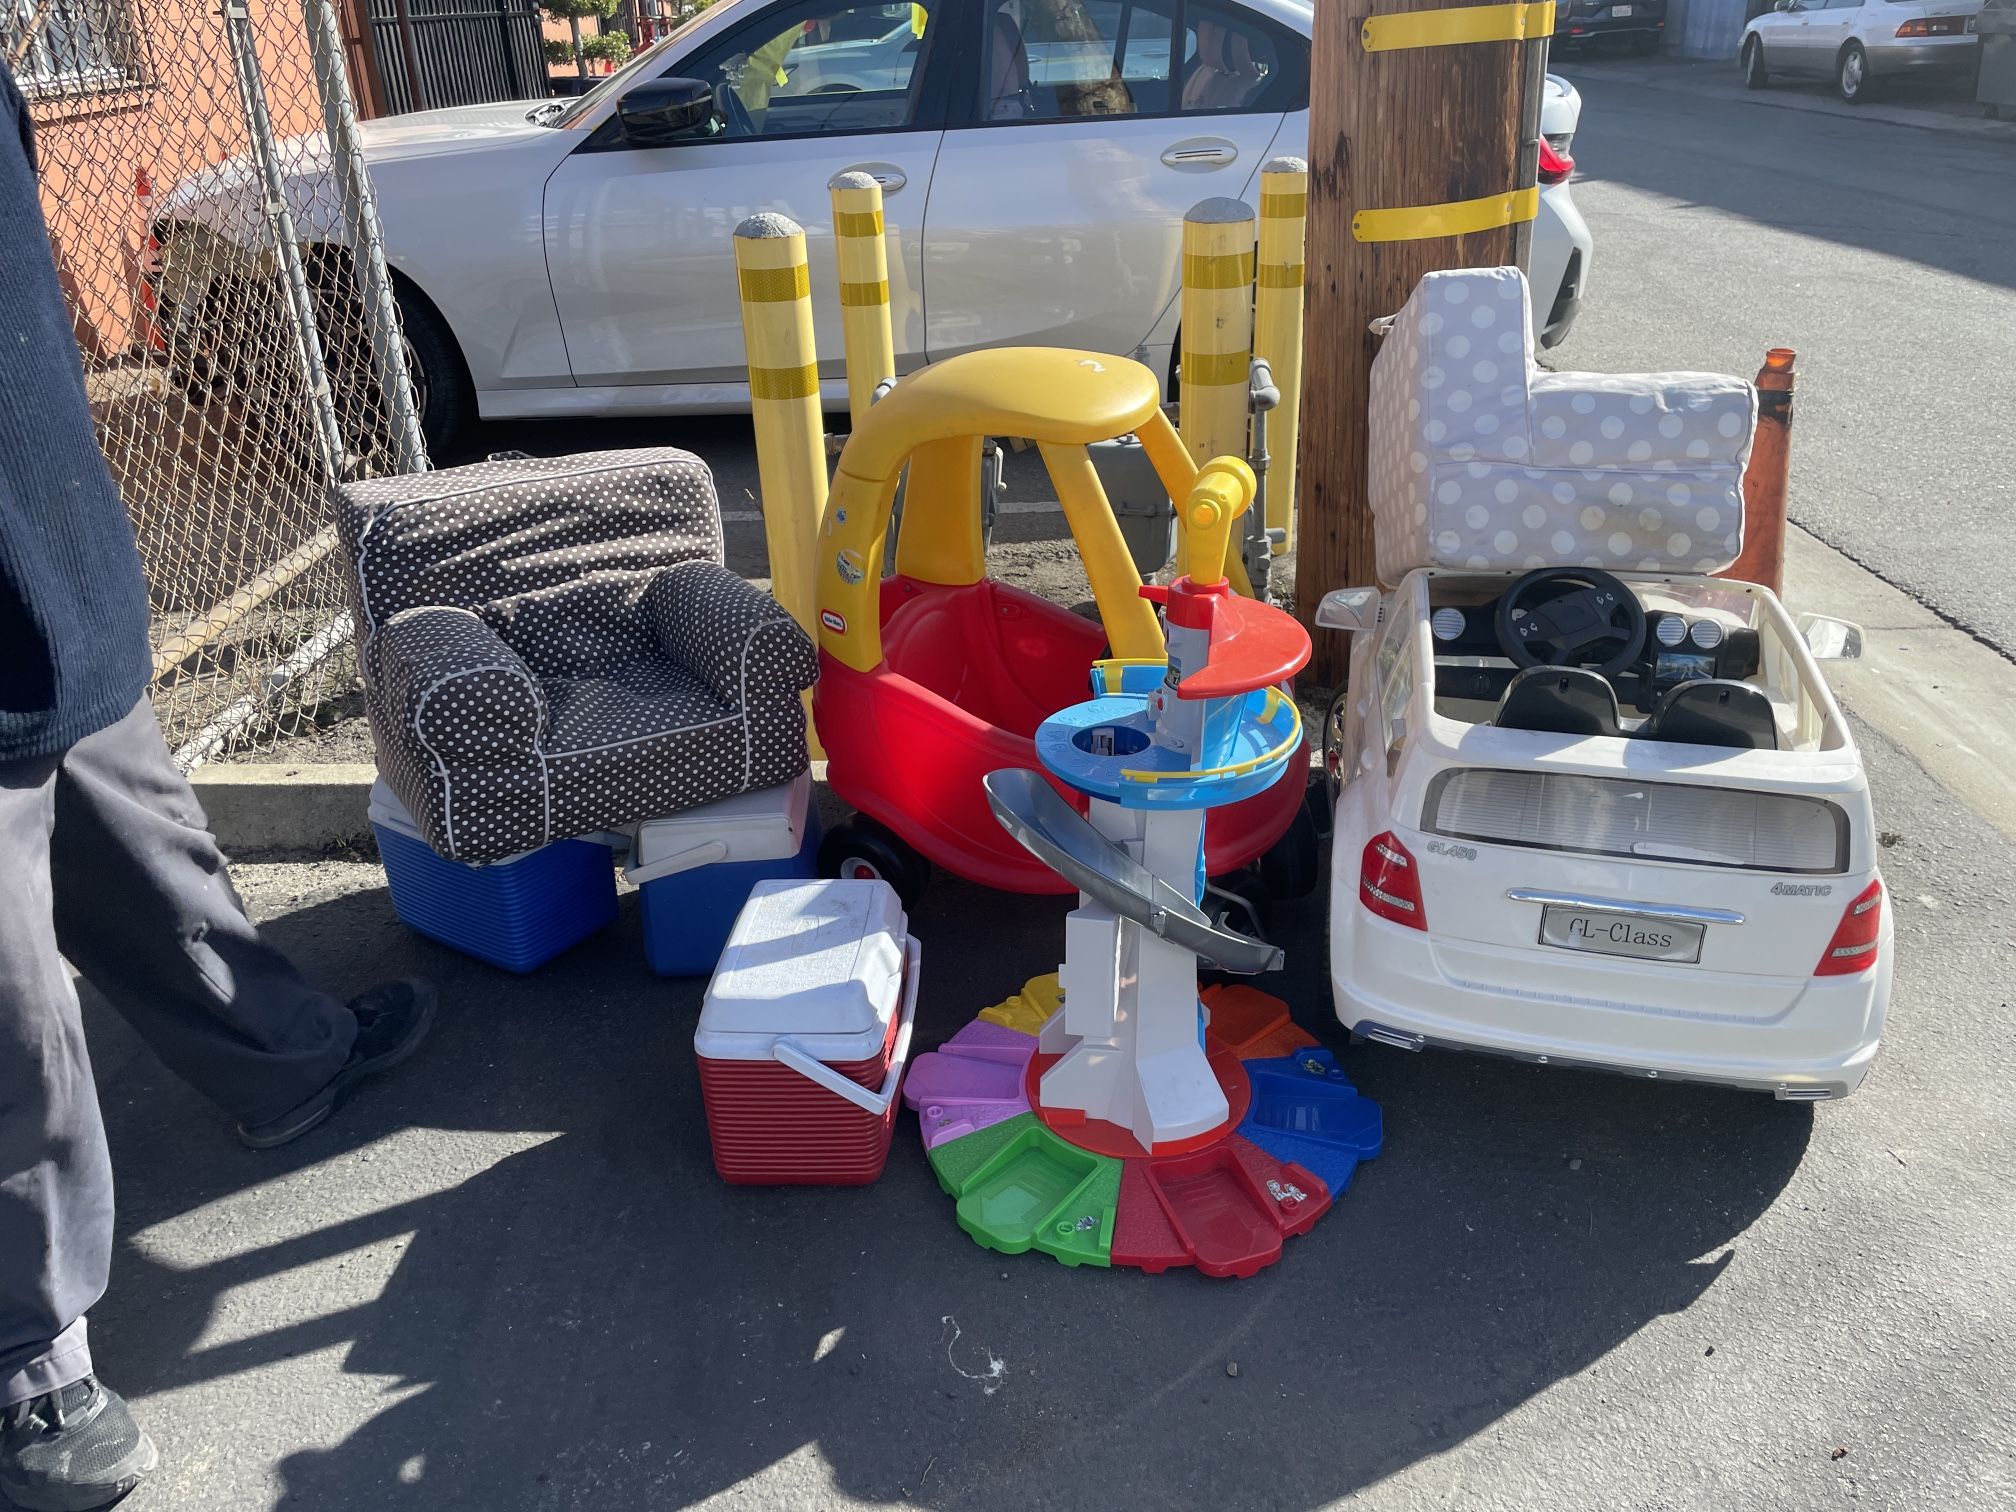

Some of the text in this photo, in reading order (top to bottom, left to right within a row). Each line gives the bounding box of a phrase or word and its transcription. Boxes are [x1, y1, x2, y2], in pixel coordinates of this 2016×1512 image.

[1427, 841, 1477, 861] GL450
[1770, 882, 1832, 896] 4MATIC
[1569, 918, 1672, 948] GL-Class
